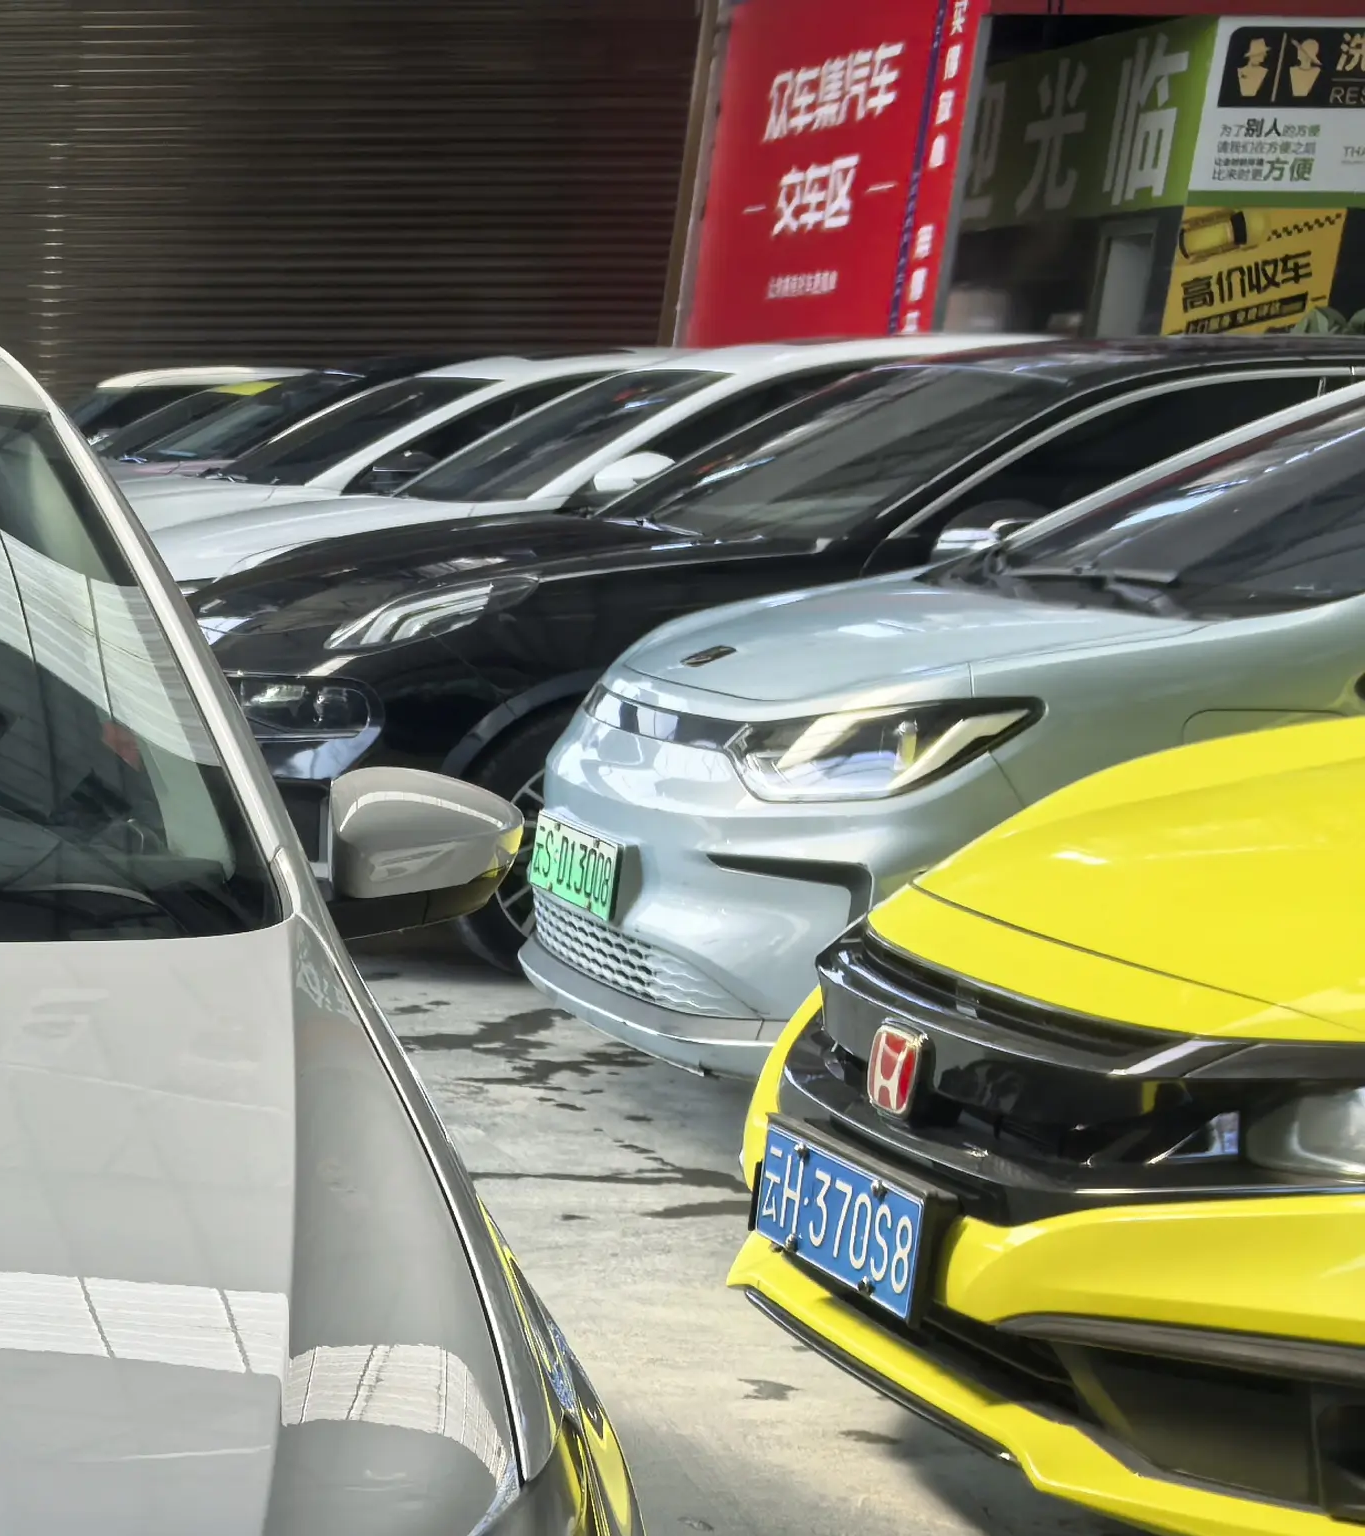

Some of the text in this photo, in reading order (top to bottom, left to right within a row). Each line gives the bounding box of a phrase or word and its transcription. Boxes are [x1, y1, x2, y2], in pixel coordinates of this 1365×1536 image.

[1220, 117, 1321, 138] 为了别人的方便
[1181, 250, 1313, 313] 高价收车
